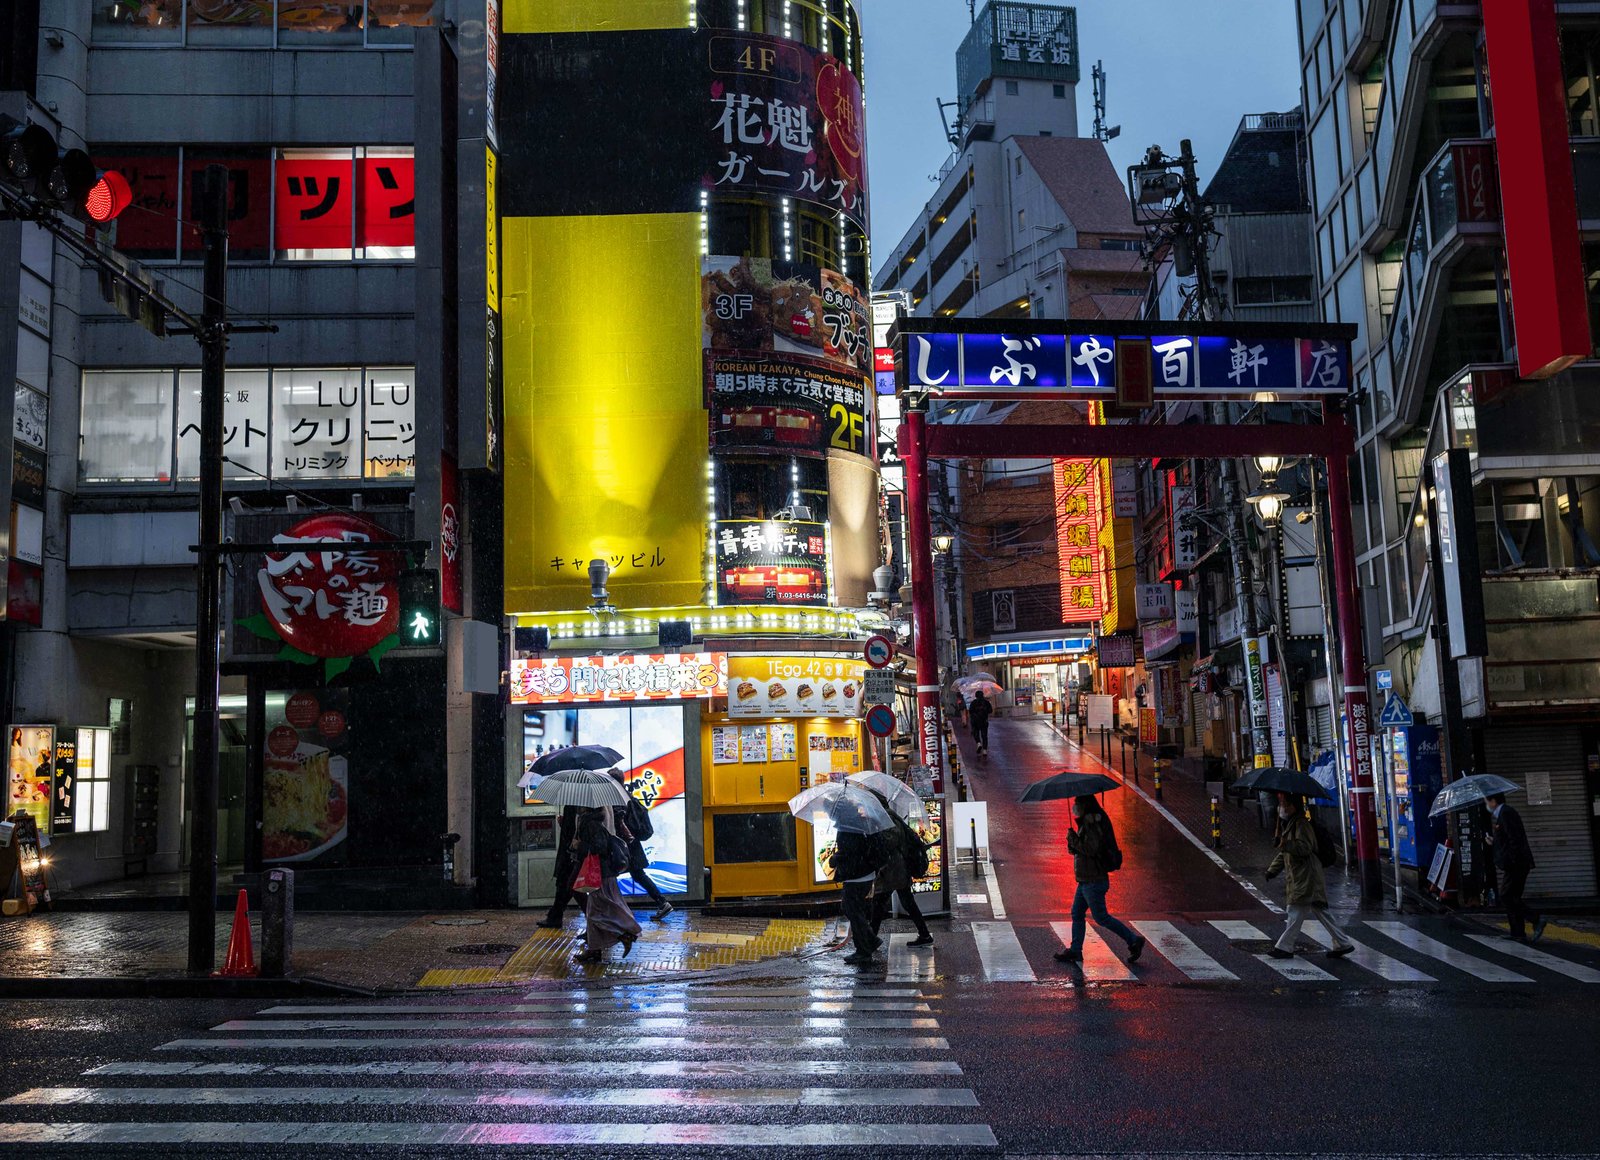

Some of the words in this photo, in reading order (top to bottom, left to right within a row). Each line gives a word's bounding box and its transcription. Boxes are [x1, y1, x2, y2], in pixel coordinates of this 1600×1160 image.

[737, 46, 777, 72] 4F
[1001, 44, 1070, 65] 道玄坂
[710, 93, 814, 153] 花魁
[715, 294, 753, 320] 3F
[715, 360, 756, 372] KOREAN
[759, 364, 800, 375] IZAKAYA
[804, 370, 824, 382] Chung
[824, 374, 841, 385] Choon
[715, 373, 864, 408] 朝5時まで元気で営業中
[829, 403, 864, 450] 2F
[284, 456, 349, 470] トリミング
[1063, 463, 1095, 608] 道頓堀劇場
[550, 547, 665, 571] キャツビル
[519, 664, 720, 695] 笑う門には福来る
[767, 661, 821, 677] TEgg.42
[922, 706, 940, 781] 渋谷百軒店
[1352, 704, 1371, 776] 渋谷百軒店
